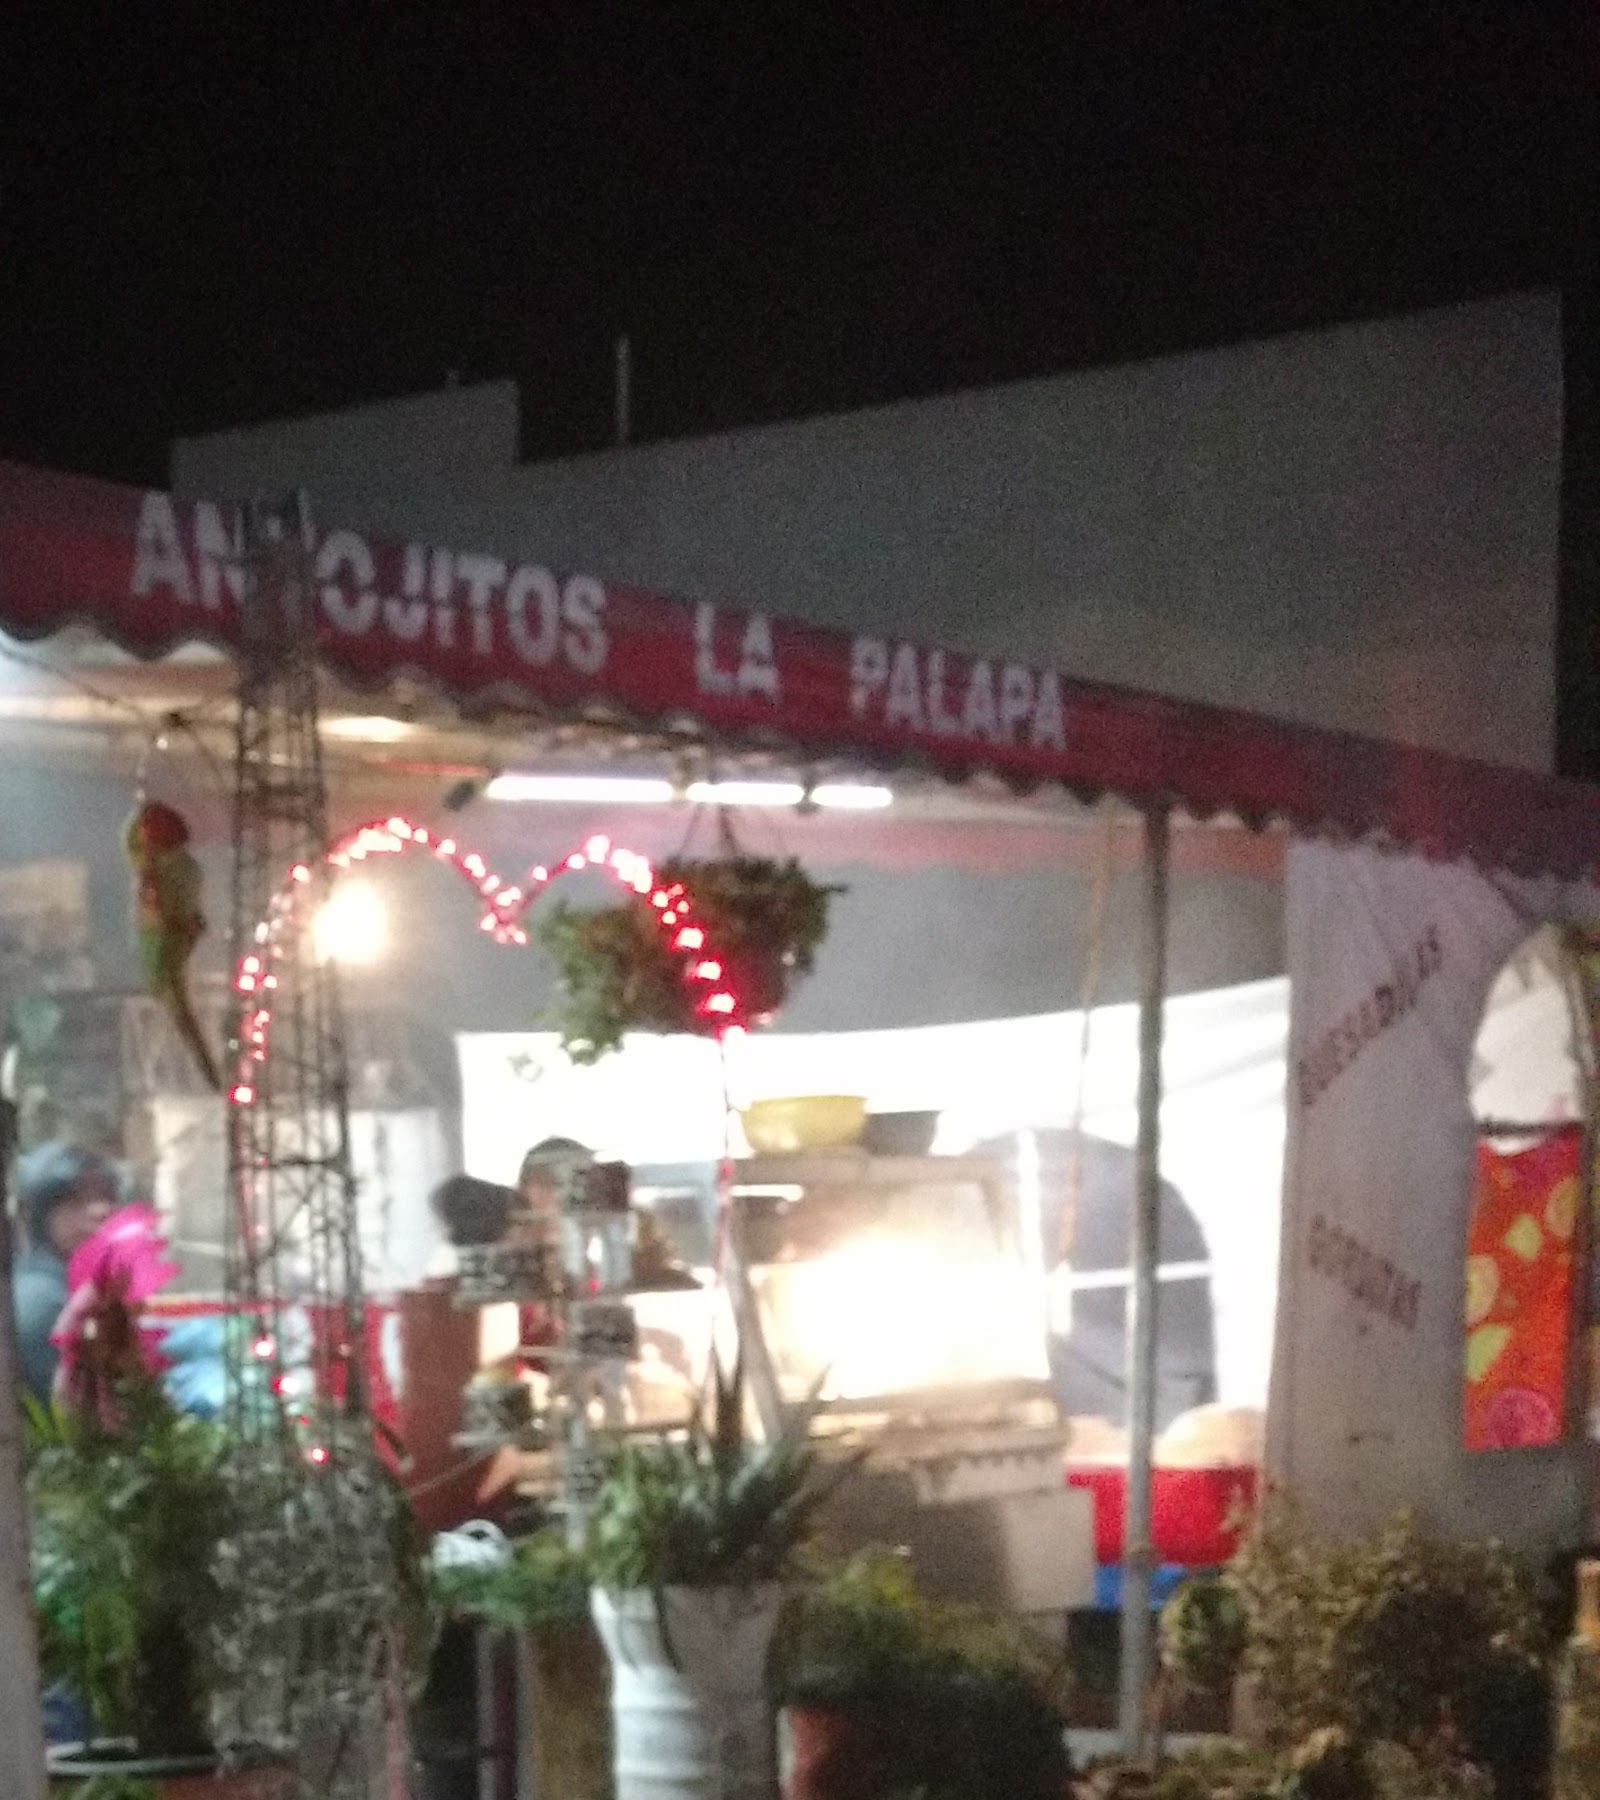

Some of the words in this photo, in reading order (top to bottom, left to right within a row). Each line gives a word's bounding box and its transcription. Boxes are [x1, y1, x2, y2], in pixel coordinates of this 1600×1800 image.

[130, 490, 608, 674] ANOJITOS
[694, 600, 780, 704] LA
[848, 633, 1067, 752] PALAPA
